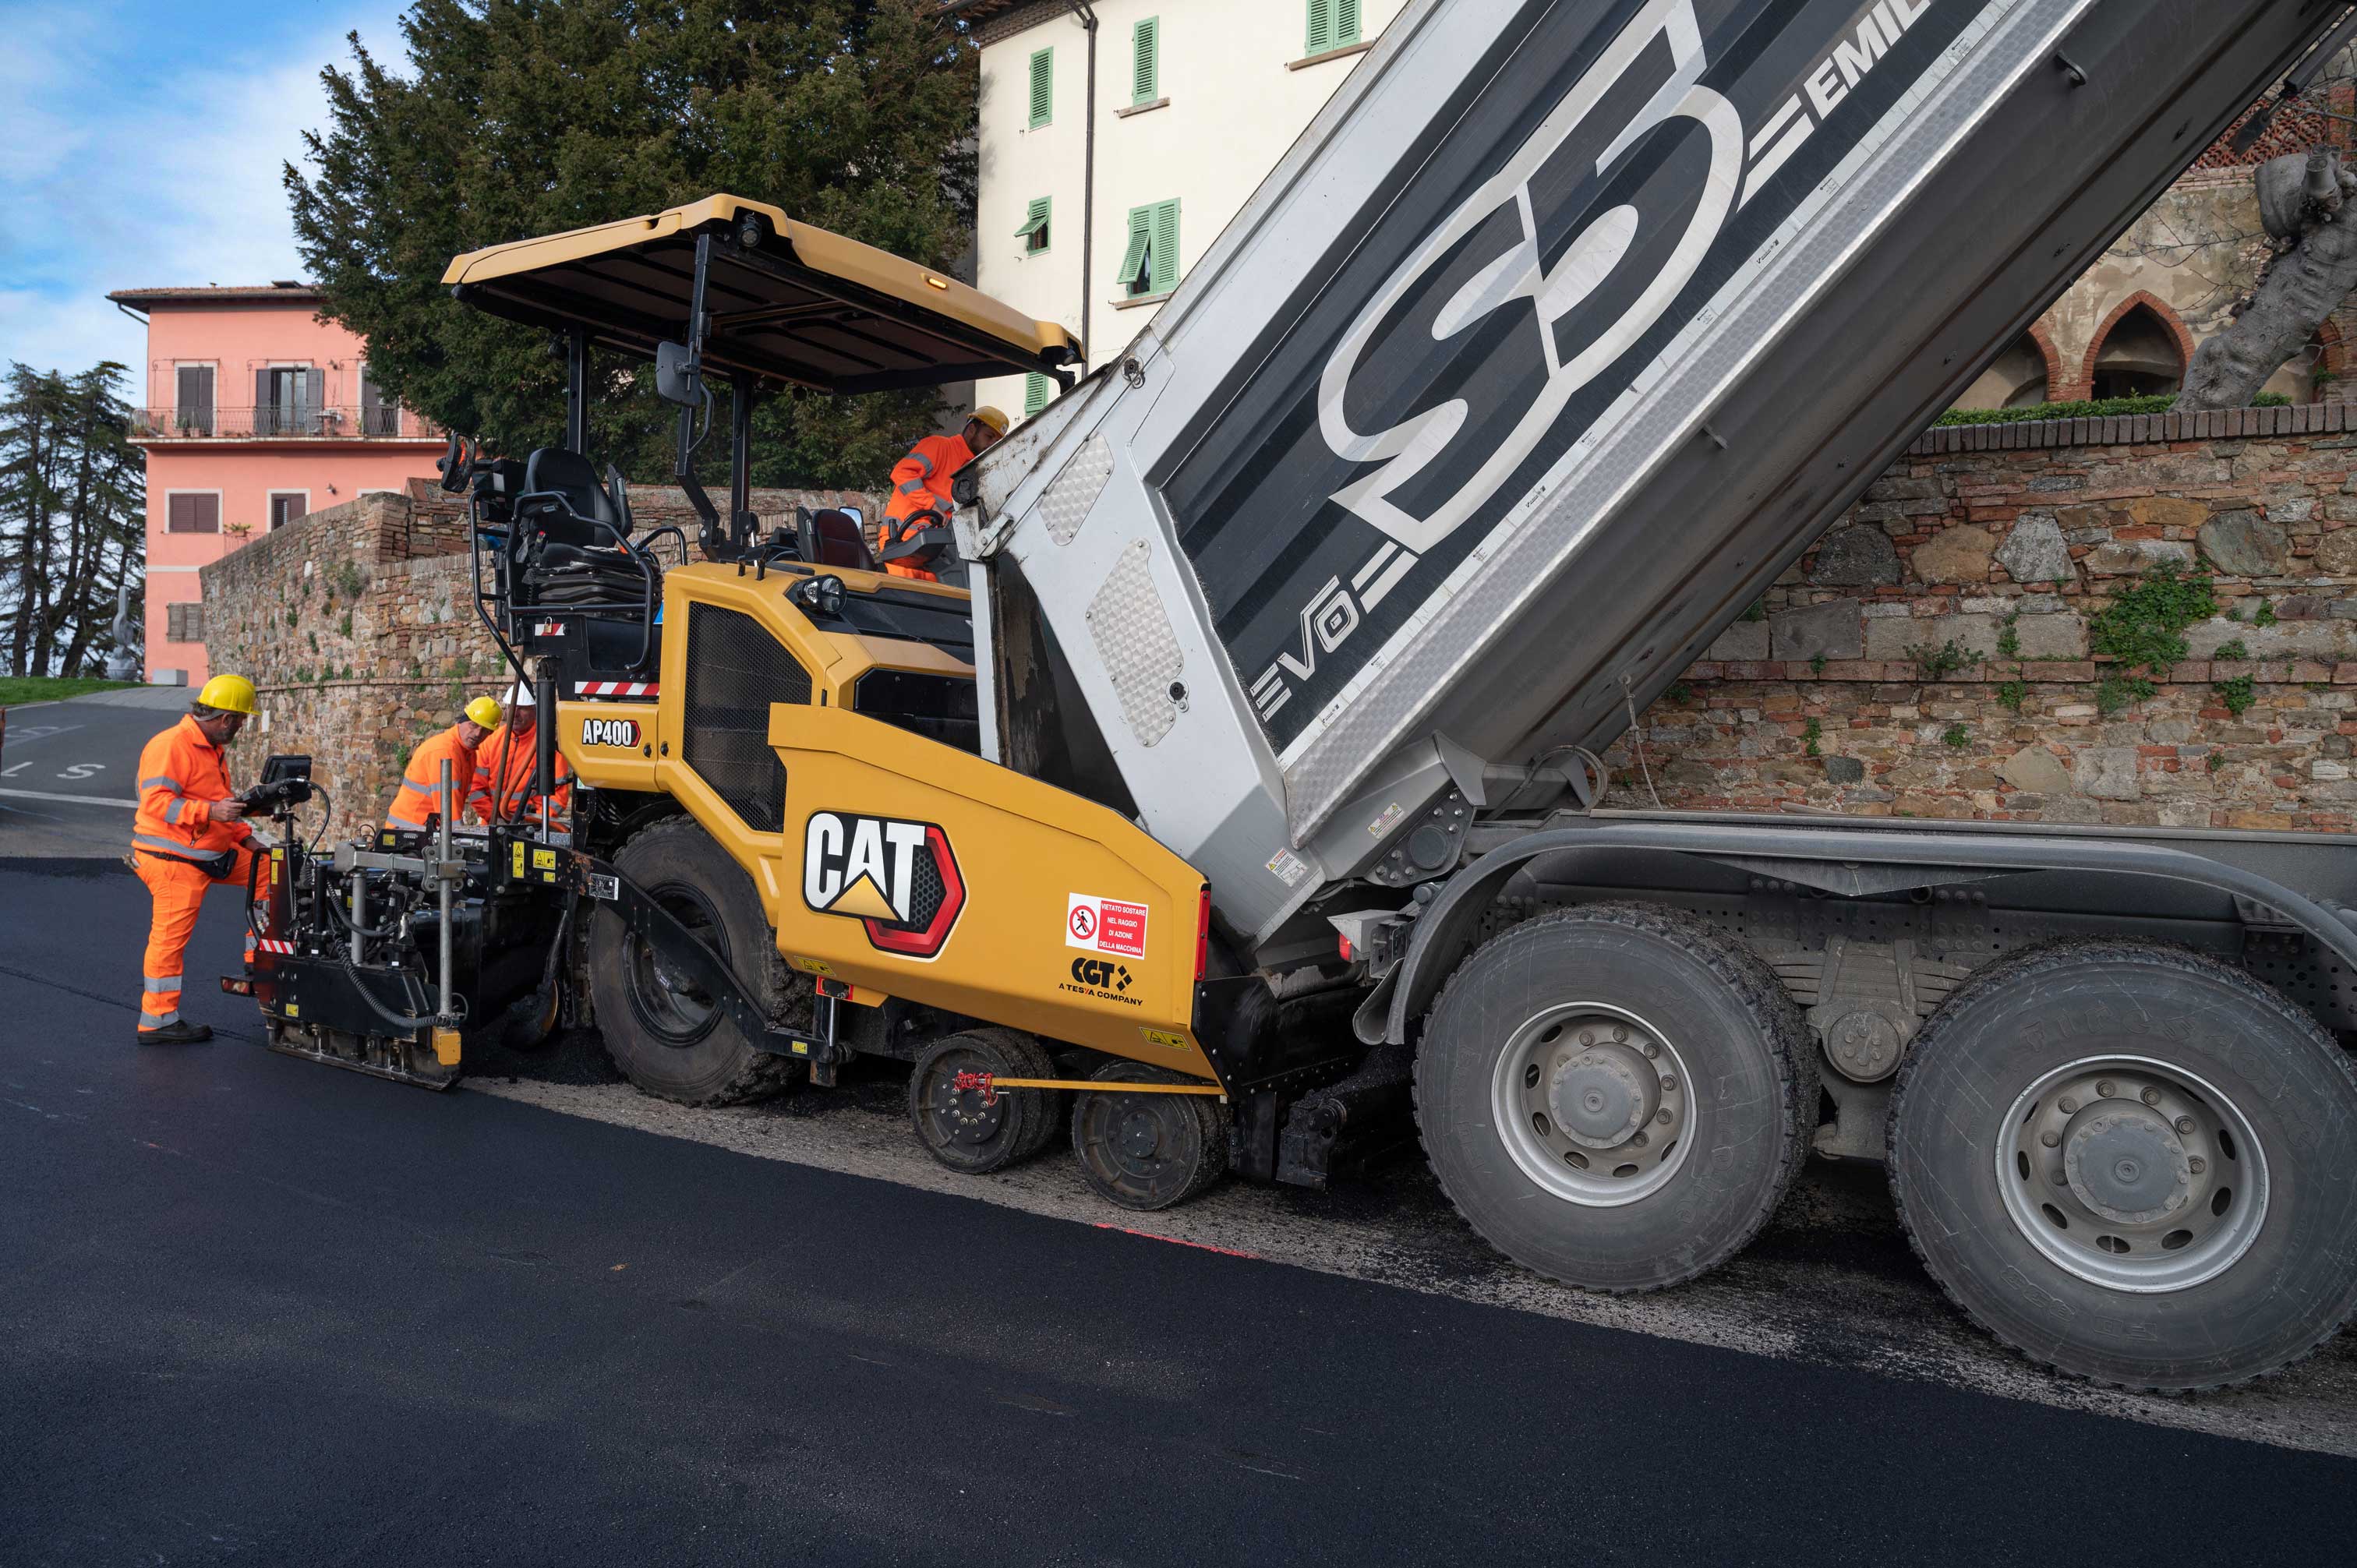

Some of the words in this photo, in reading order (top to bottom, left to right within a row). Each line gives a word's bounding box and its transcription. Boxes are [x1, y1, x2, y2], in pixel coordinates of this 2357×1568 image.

[1249, 575, 1359, 722] EVO
[582, 719, 632, 746] AP400
[805, 813, 925, 922] CAT
[1101, 903, 1122, 913] VIETATO
[1122, 907, 1146, 916] SOSTARE
[1118, 919, 1138, 927] RAGGIO
[1115, 931, 1133, 939] AZIONE
[1099, 941, 1115, 949] DELLA
[1116, 944, 1142, 954] MACCHINA
[1072, 957, 1115, 988] CGT
[1097, 991, 1143, 1006] COMPANY
